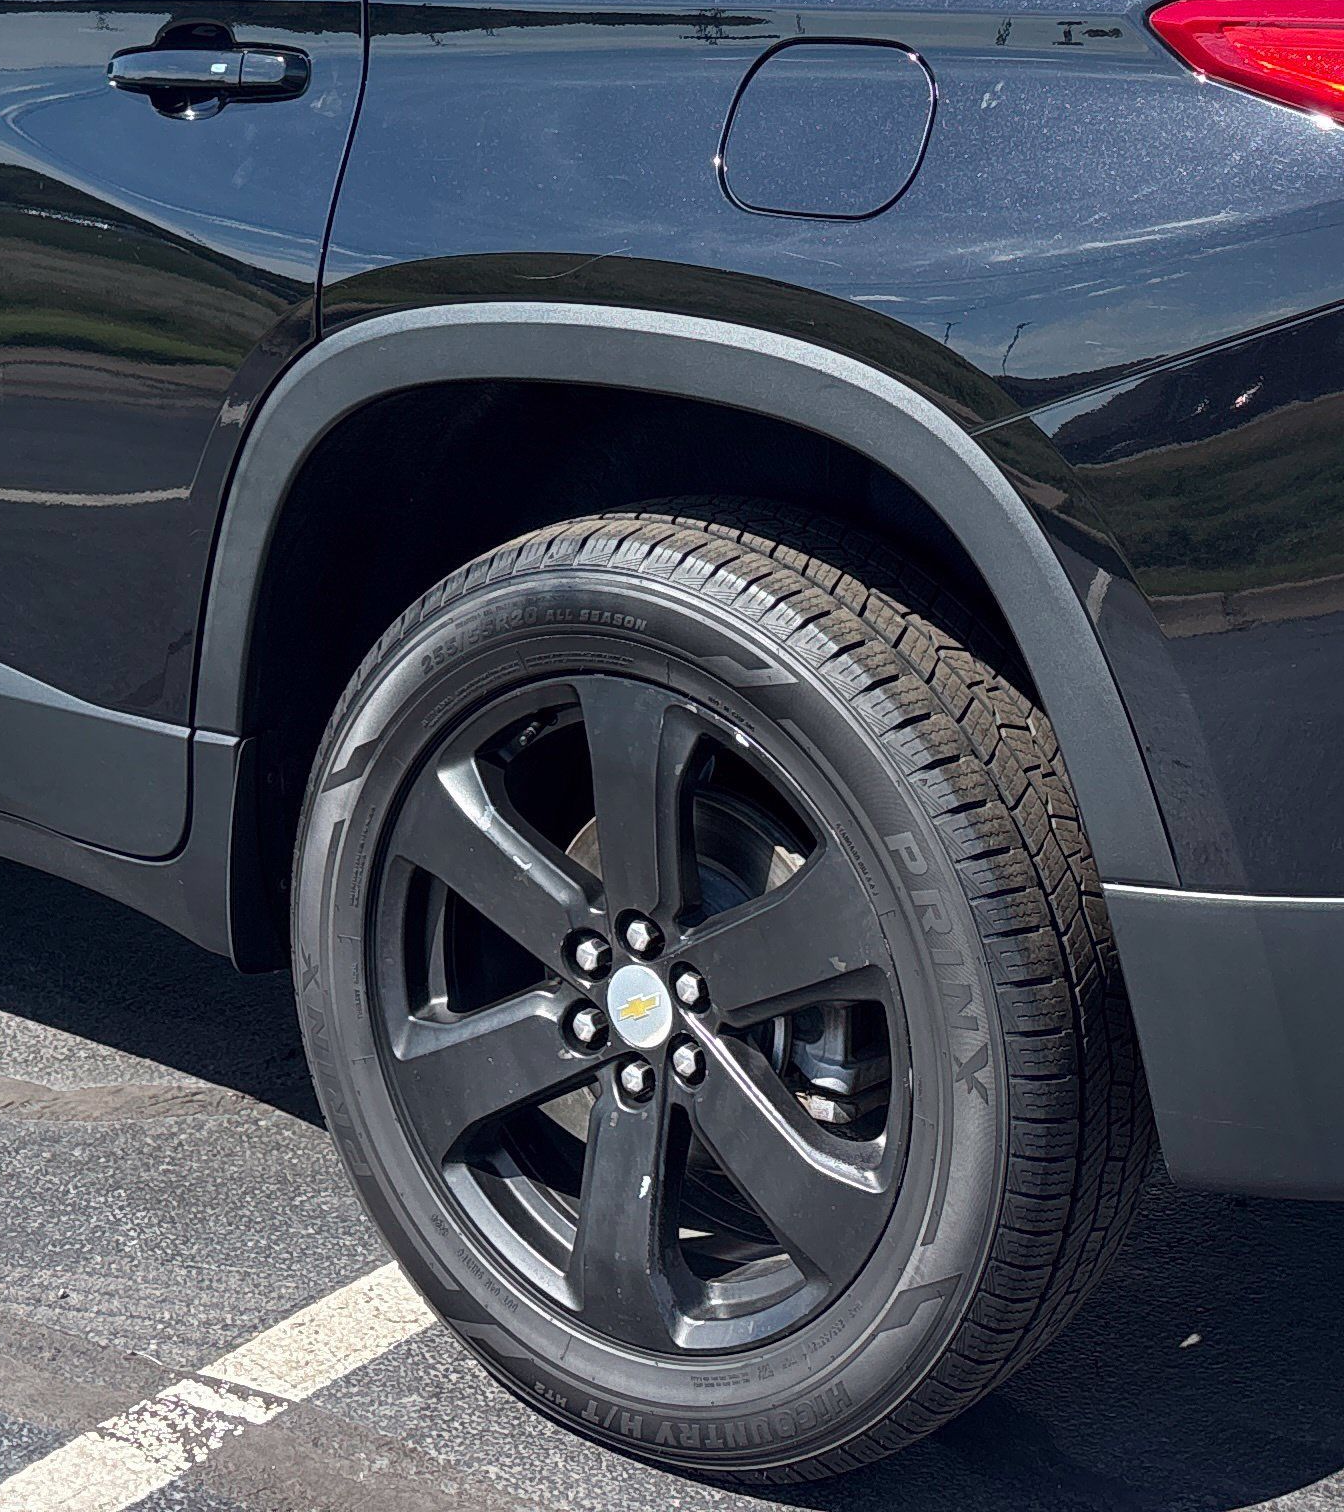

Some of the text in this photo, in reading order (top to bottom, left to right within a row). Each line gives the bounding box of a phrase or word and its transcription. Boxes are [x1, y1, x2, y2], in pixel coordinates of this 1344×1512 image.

[421, 605, 538, 676] 255/55R20
[544, 609, 574, 623] ALL
[579, 609, 648, 631] SEASON
[883, 831, 989, 1106] PRINX
[533, 1380, 568, 1408] HT2
[580, 1399, 643, 1439] H/T
